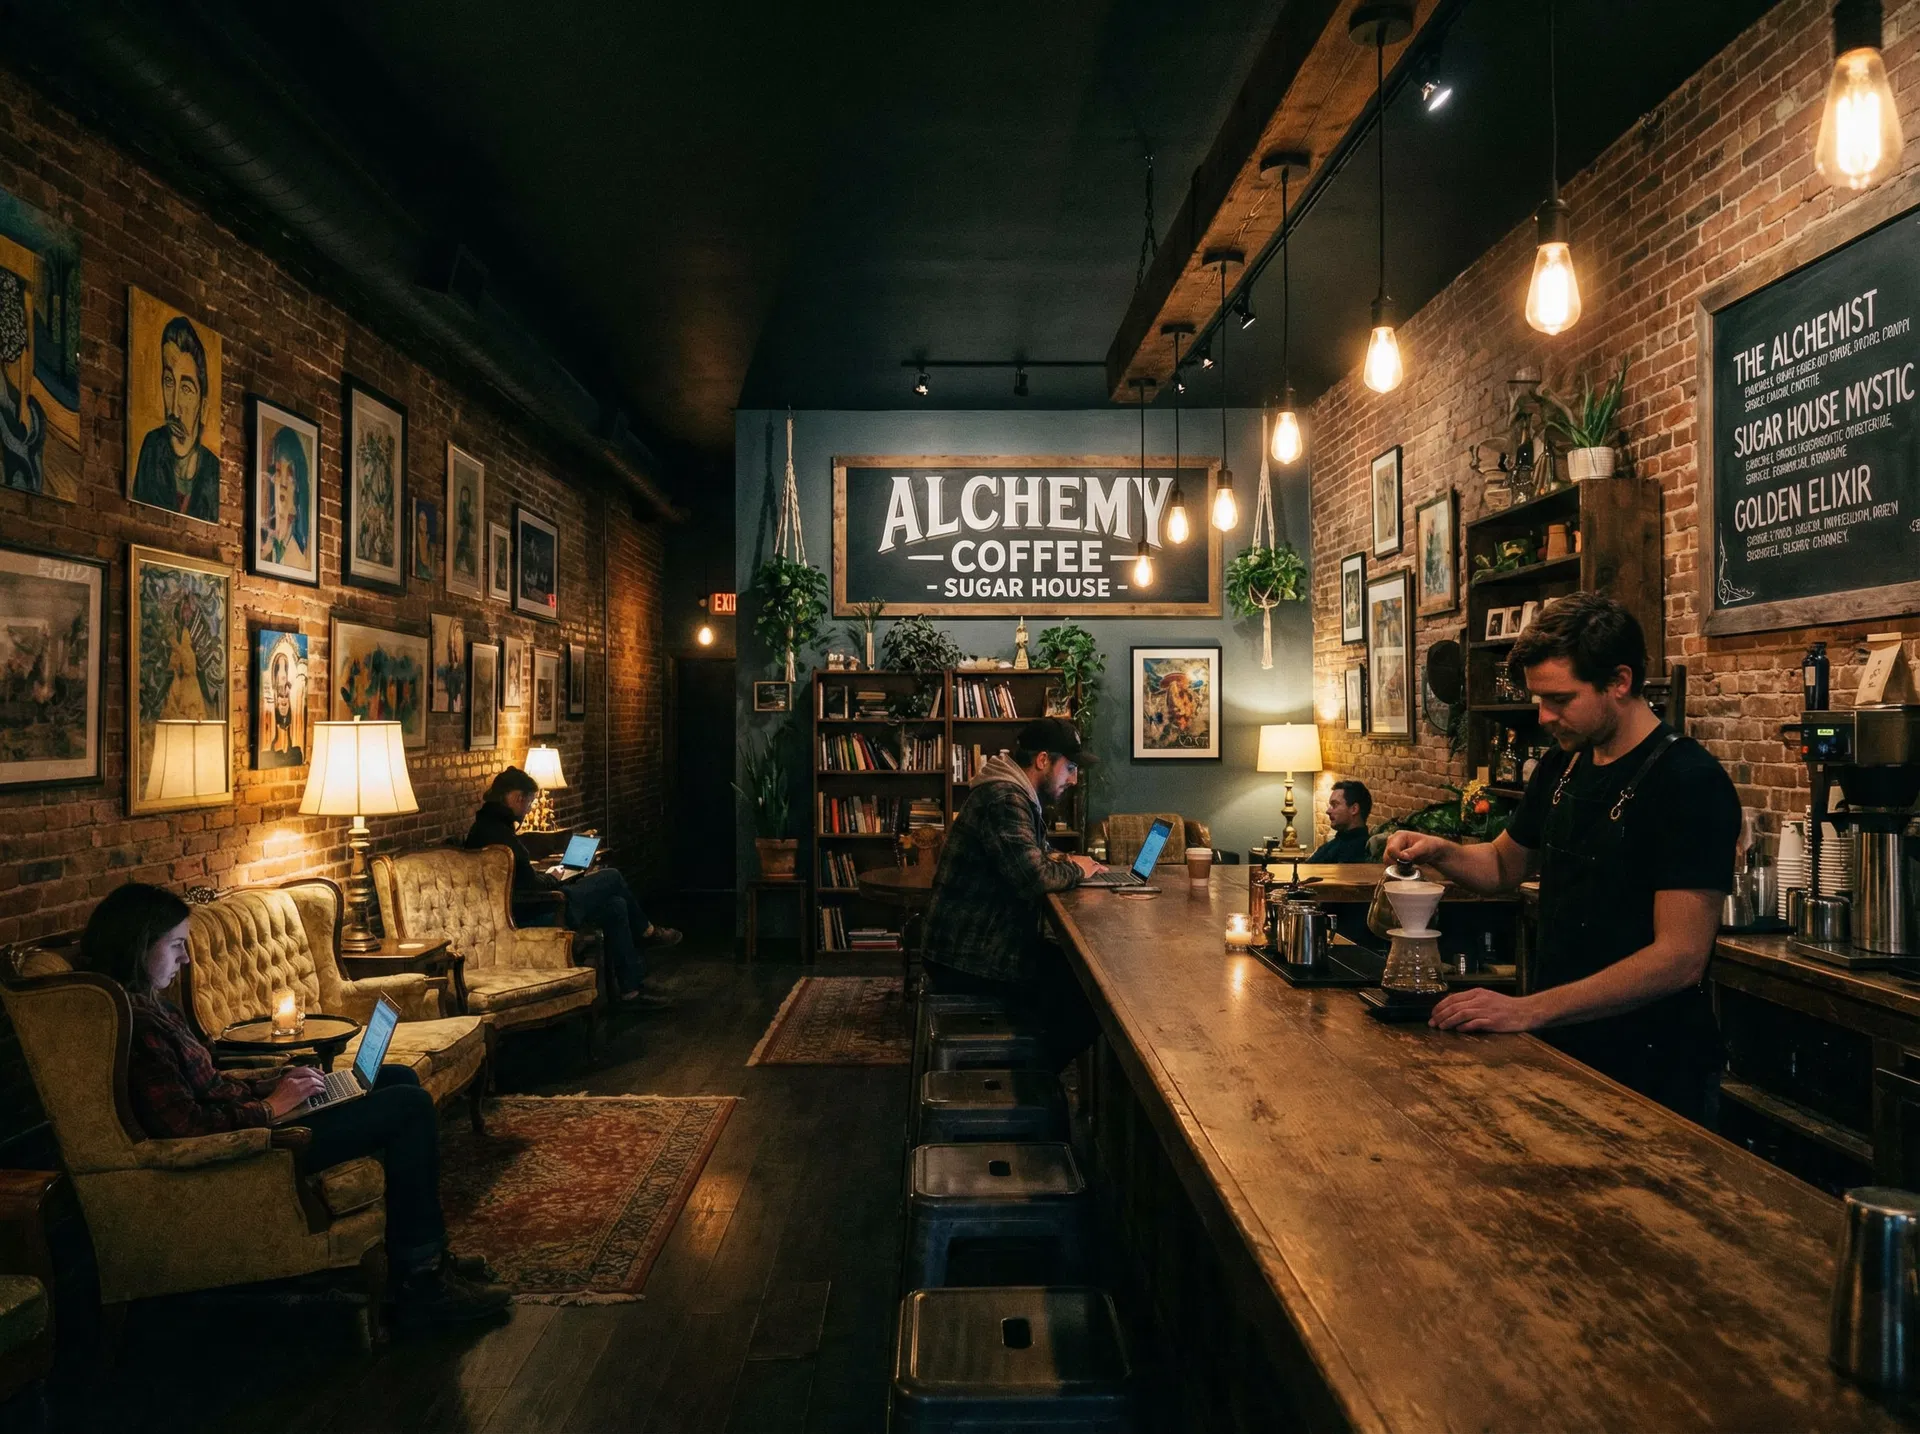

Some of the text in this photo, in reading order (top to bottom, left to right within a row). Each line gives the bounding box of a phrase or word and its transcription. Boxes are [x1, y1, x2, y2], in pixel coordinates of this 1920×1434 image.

[1733, 343, 1767, 385] THE
[1770, 288, 1878, 370] ALCHEMIST
[1734, 413, 1783, 458] SUGAR
[1787, 390, 1840, 441] HOUSE
[1846, 362, 1915, 421] MYSTIC
[878, 475, 1175, 552] ALCHEMY
[1734, 483, 1801, 532] GOLDEN
[1808, 464, 1872, 514] ELIXIR
[944, 577, 1111, 598] SUGAR HOUSE
[951, 540, 1103, 573] COFFEE
